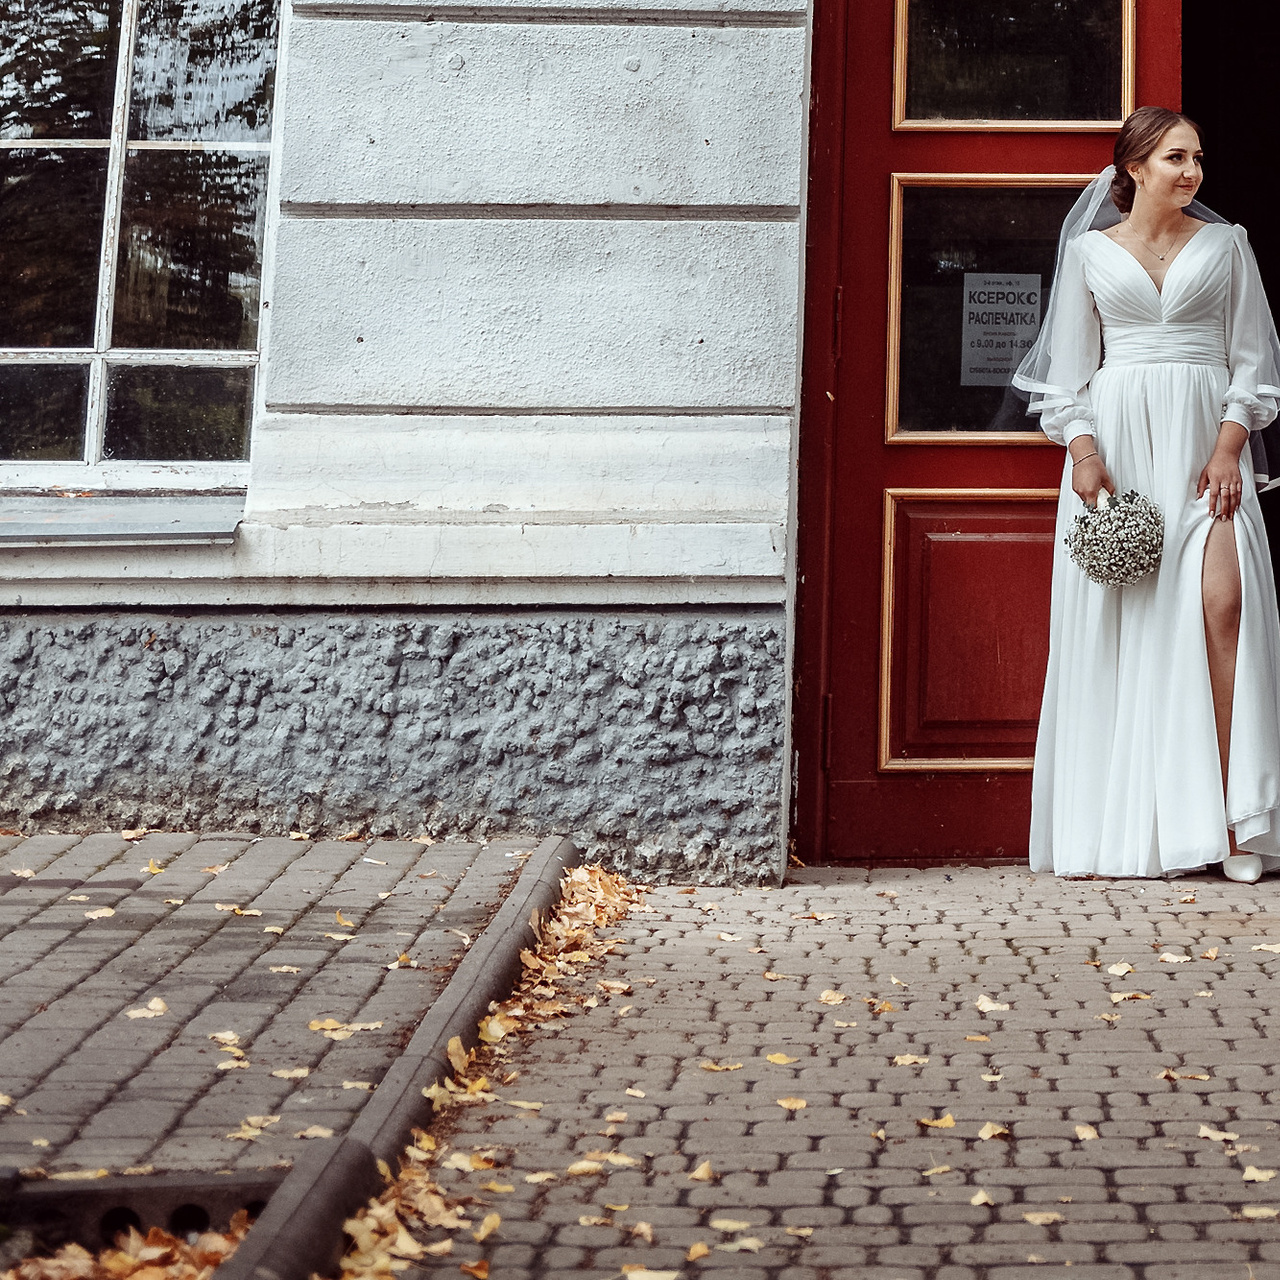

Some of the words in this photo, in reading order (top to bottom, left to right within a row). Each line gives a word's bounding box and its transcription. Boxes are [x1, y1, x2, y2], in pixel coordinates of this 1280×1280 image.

[968, 290, 1038, 305] КСЕРОКС
[968, 311, 1036, 326] РАСПЕЧАТКА
[976, 339, 994, 348] 9.00
[995, 340, 1006, 349] до
